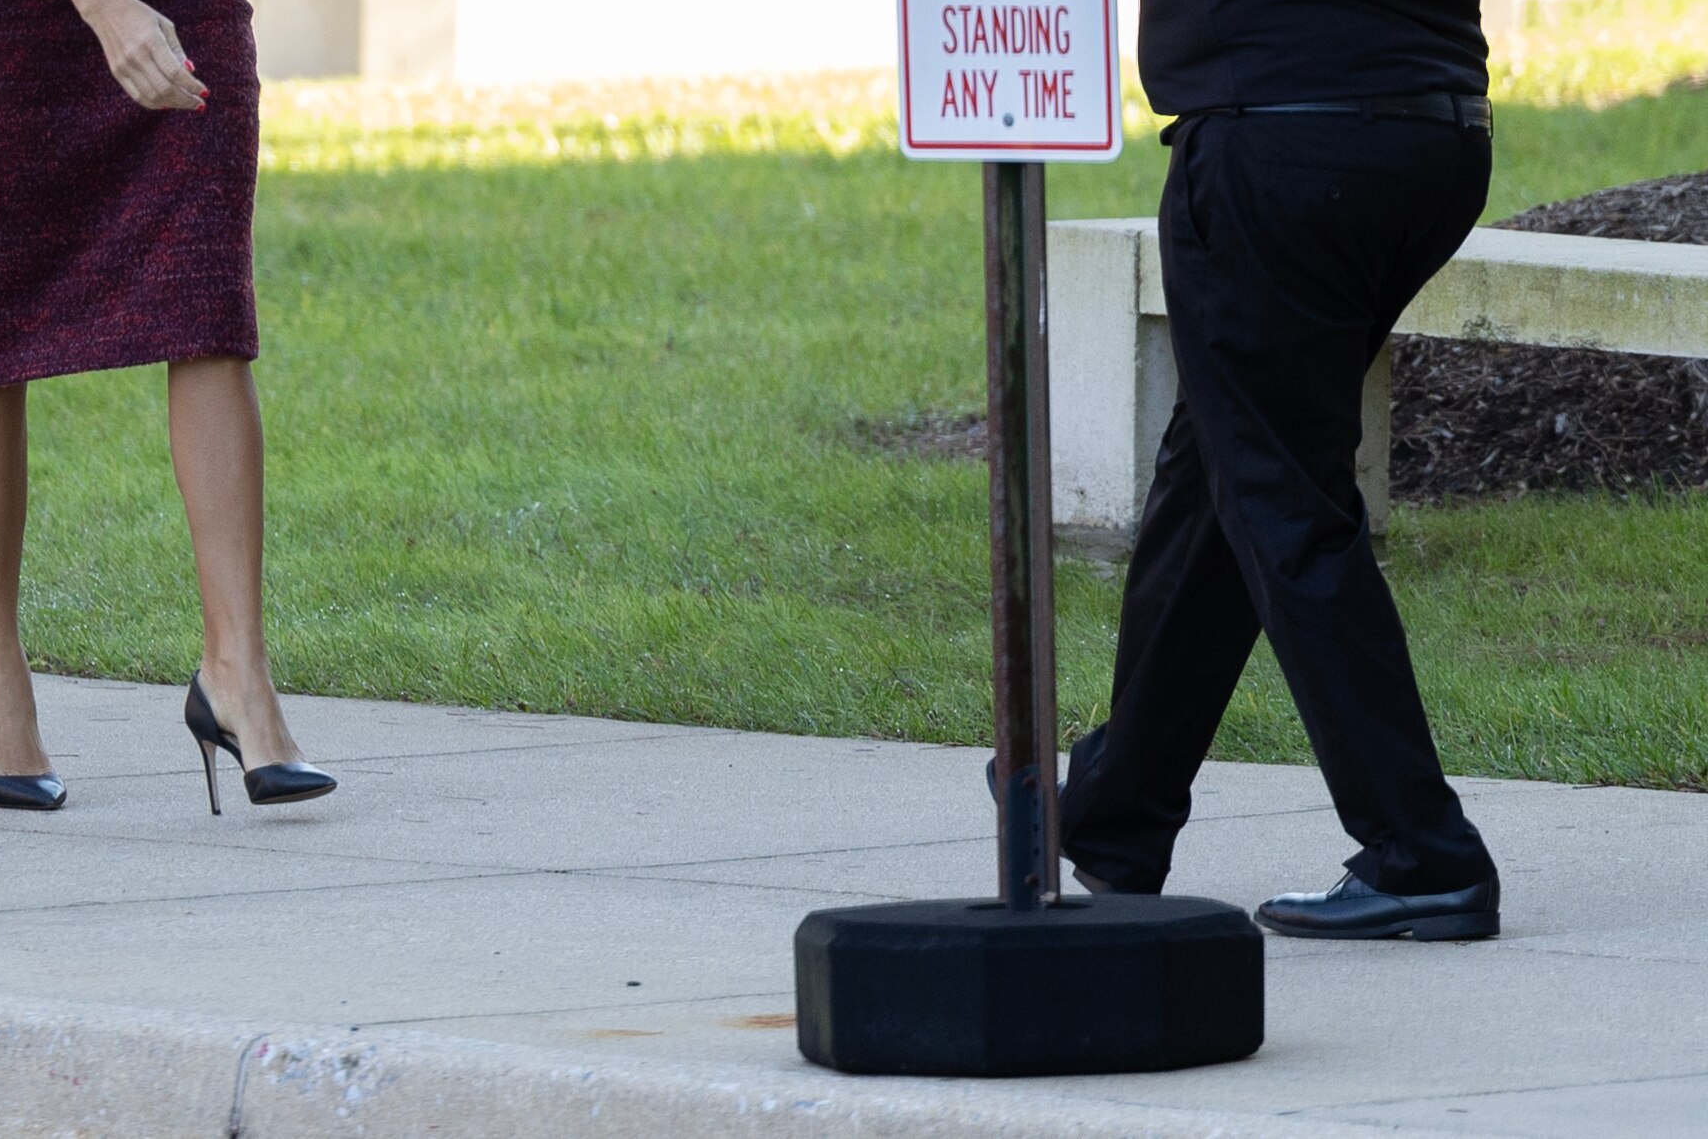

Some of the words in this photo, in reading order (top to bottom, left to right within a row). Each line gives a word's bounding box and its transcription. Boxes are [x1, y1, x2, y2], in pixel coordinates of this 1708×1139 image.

[942, 6, 1070, 54] STANDING
[941, 70, 998, 118] ANY
[1019, 70, 1075, 119] TIME
